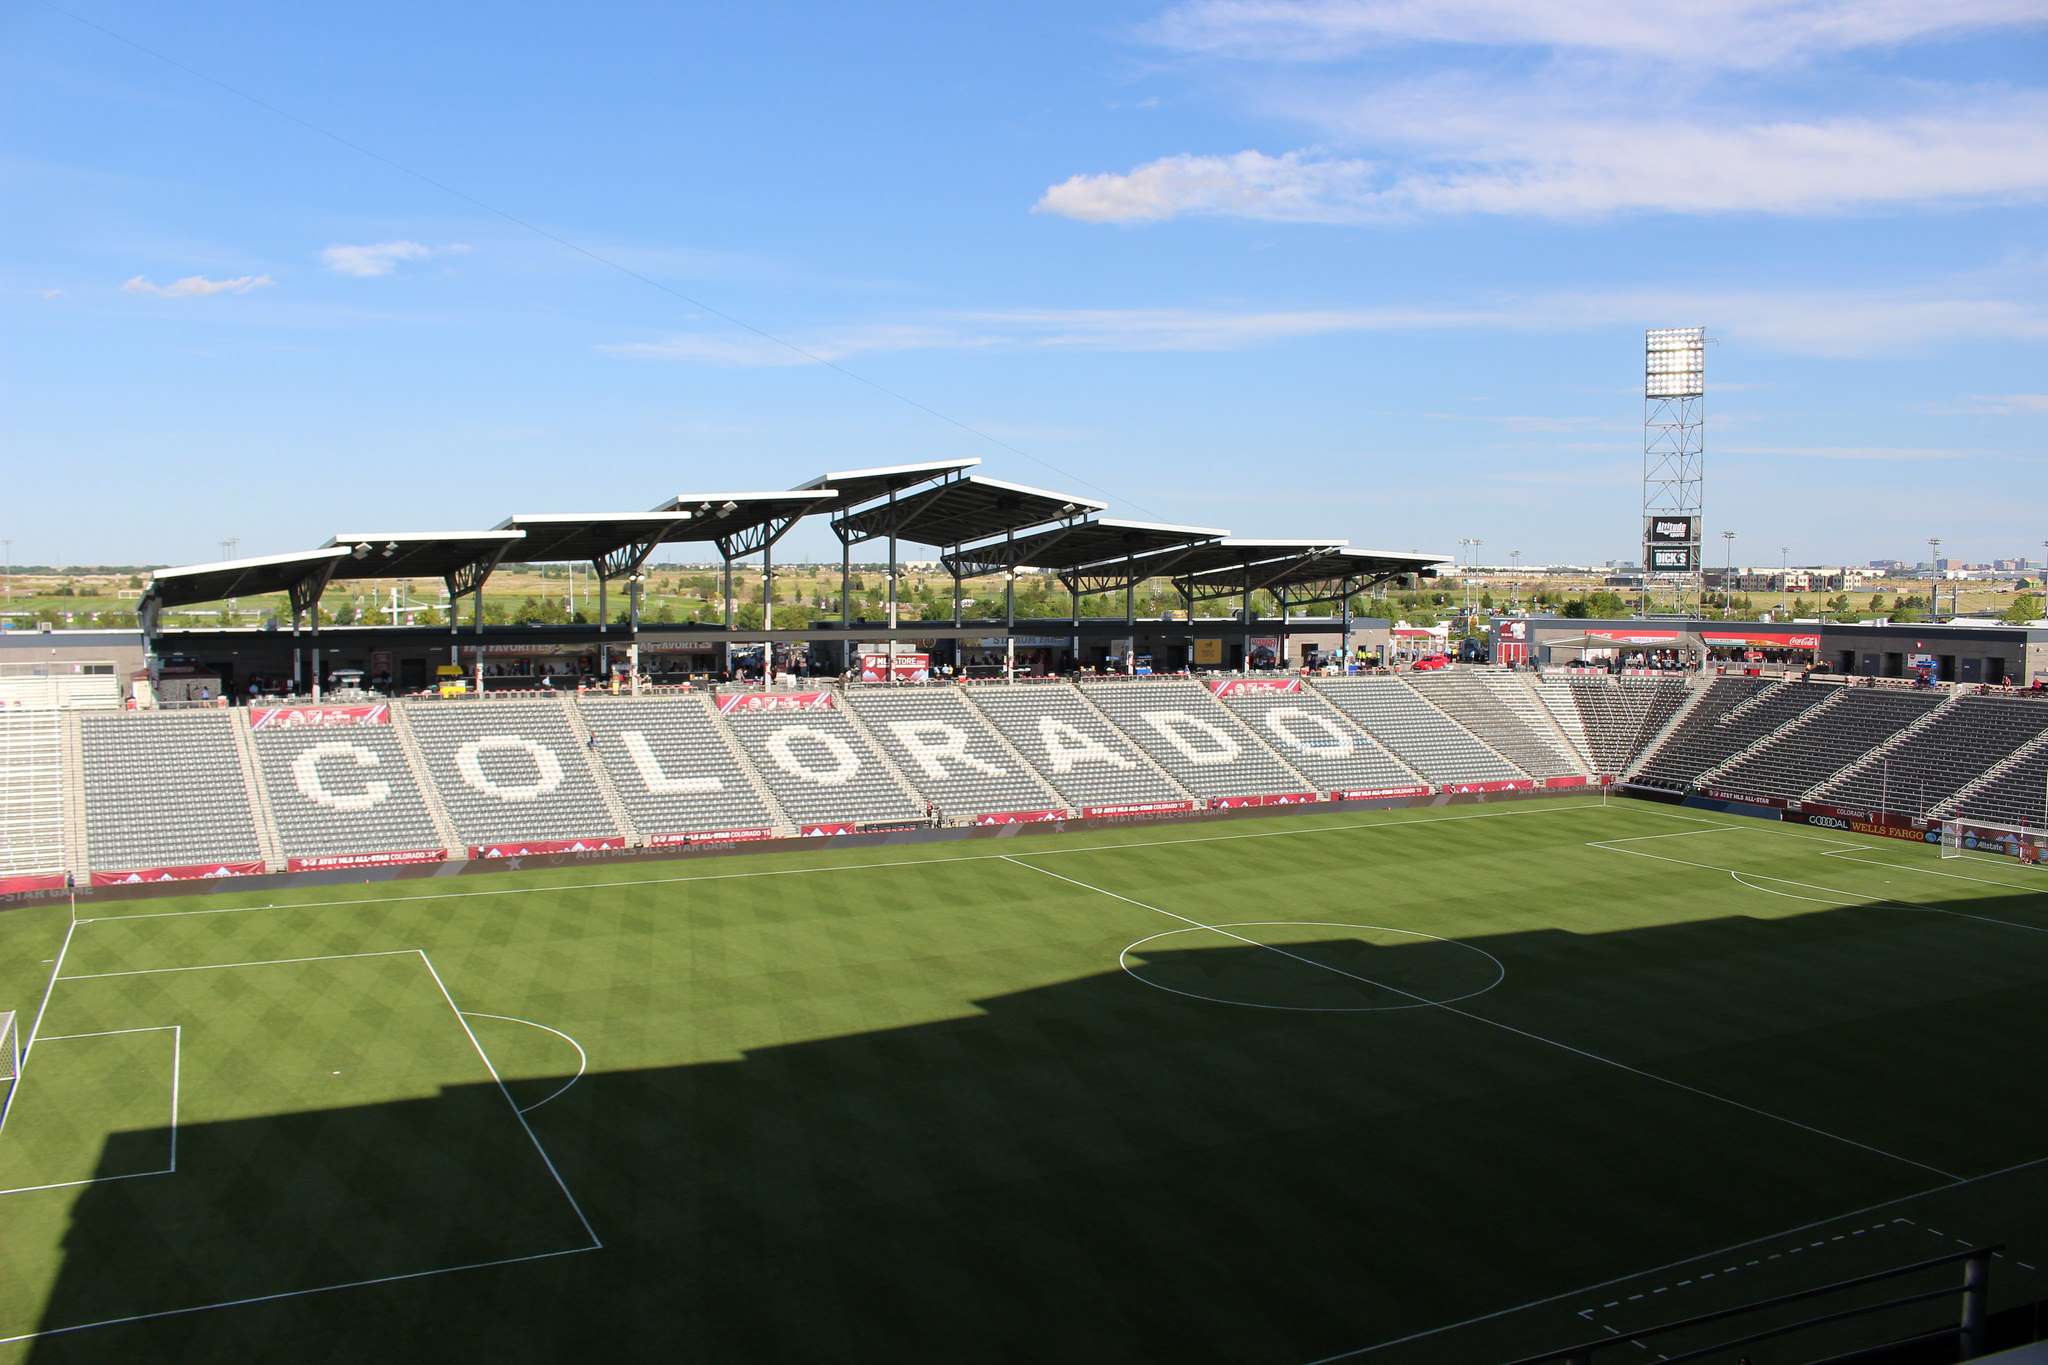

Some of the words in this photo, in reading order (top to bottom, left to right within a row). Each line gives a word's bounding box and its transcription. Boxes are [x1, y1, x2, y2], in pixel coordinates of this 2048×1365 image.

[1745, 794, 1770, 804] ALL-STAR
[1836, 808, 1865, 818] COLORADO
[700, 832, 731, 840] ALL-STAR
[731, 830, 761, 838] COLORADO
[1851, 821, 1887, 835] WELLS
[1889, 827, 1924, 840] FARGO
[639, 844, 700, 856] ALL-STAR
[1976, 840, 2005, 852] Allstate
[355, 855, 390, 863] ALL-STAR
[390, 852, 425, 860] COLORADO
